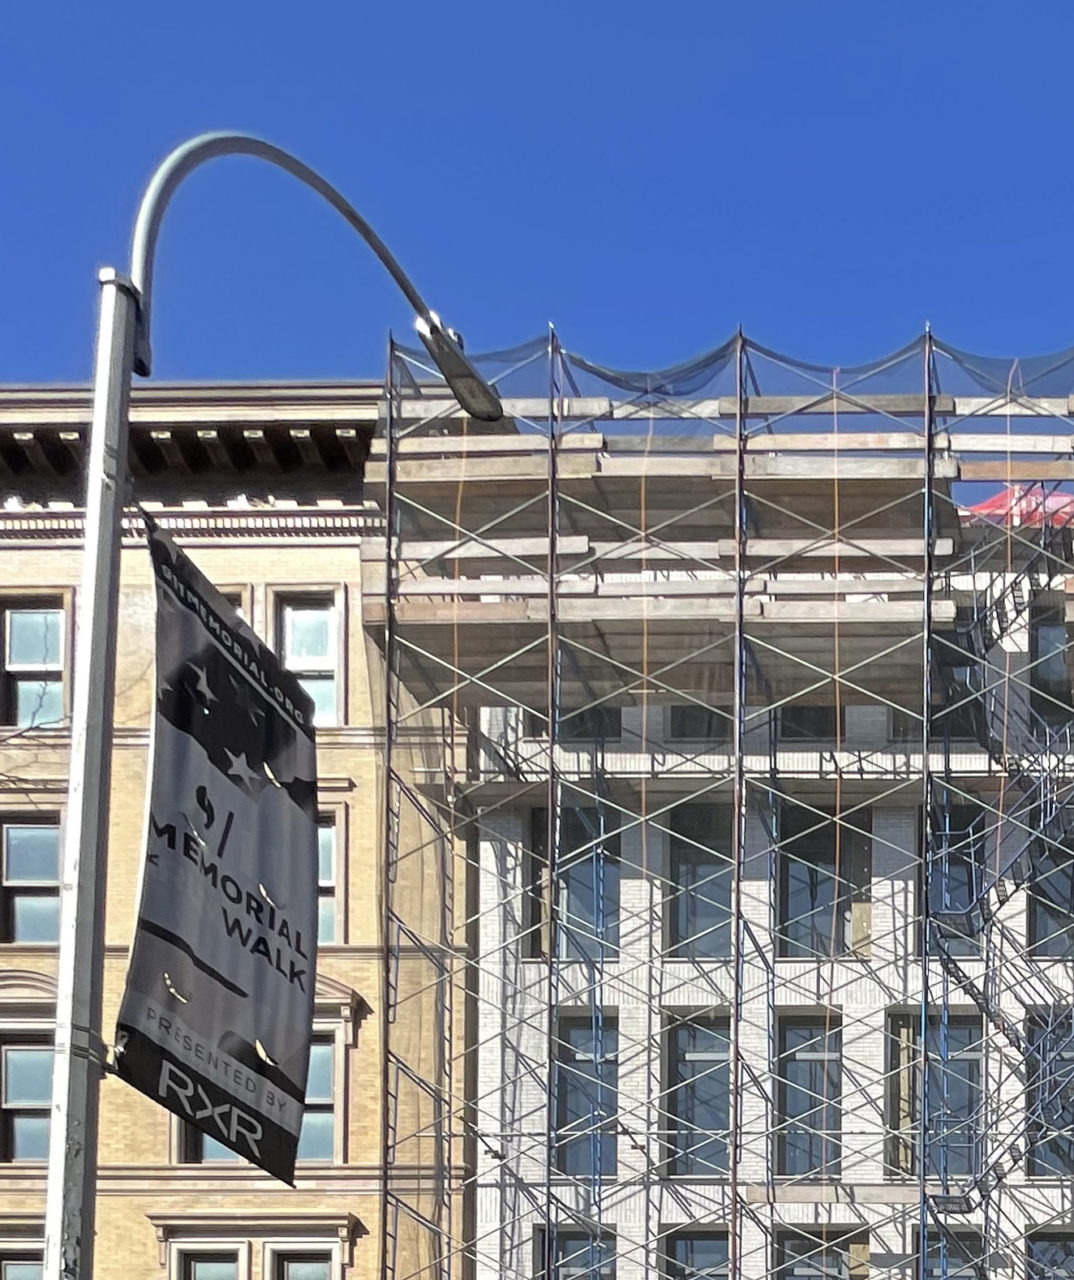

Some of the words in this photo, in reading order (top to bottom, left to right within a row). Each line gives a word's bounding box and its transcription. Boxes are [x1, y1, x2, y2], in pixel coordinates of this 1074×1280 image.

[151, 814, 309, 961] MEMORIAL
[221, 905, 307, 995] WALK
[146, 1007, 257, 1094] PRESENTED
[265, 1091, 288, 1113] BY
[158, 1058, 264, 1160] RXR
